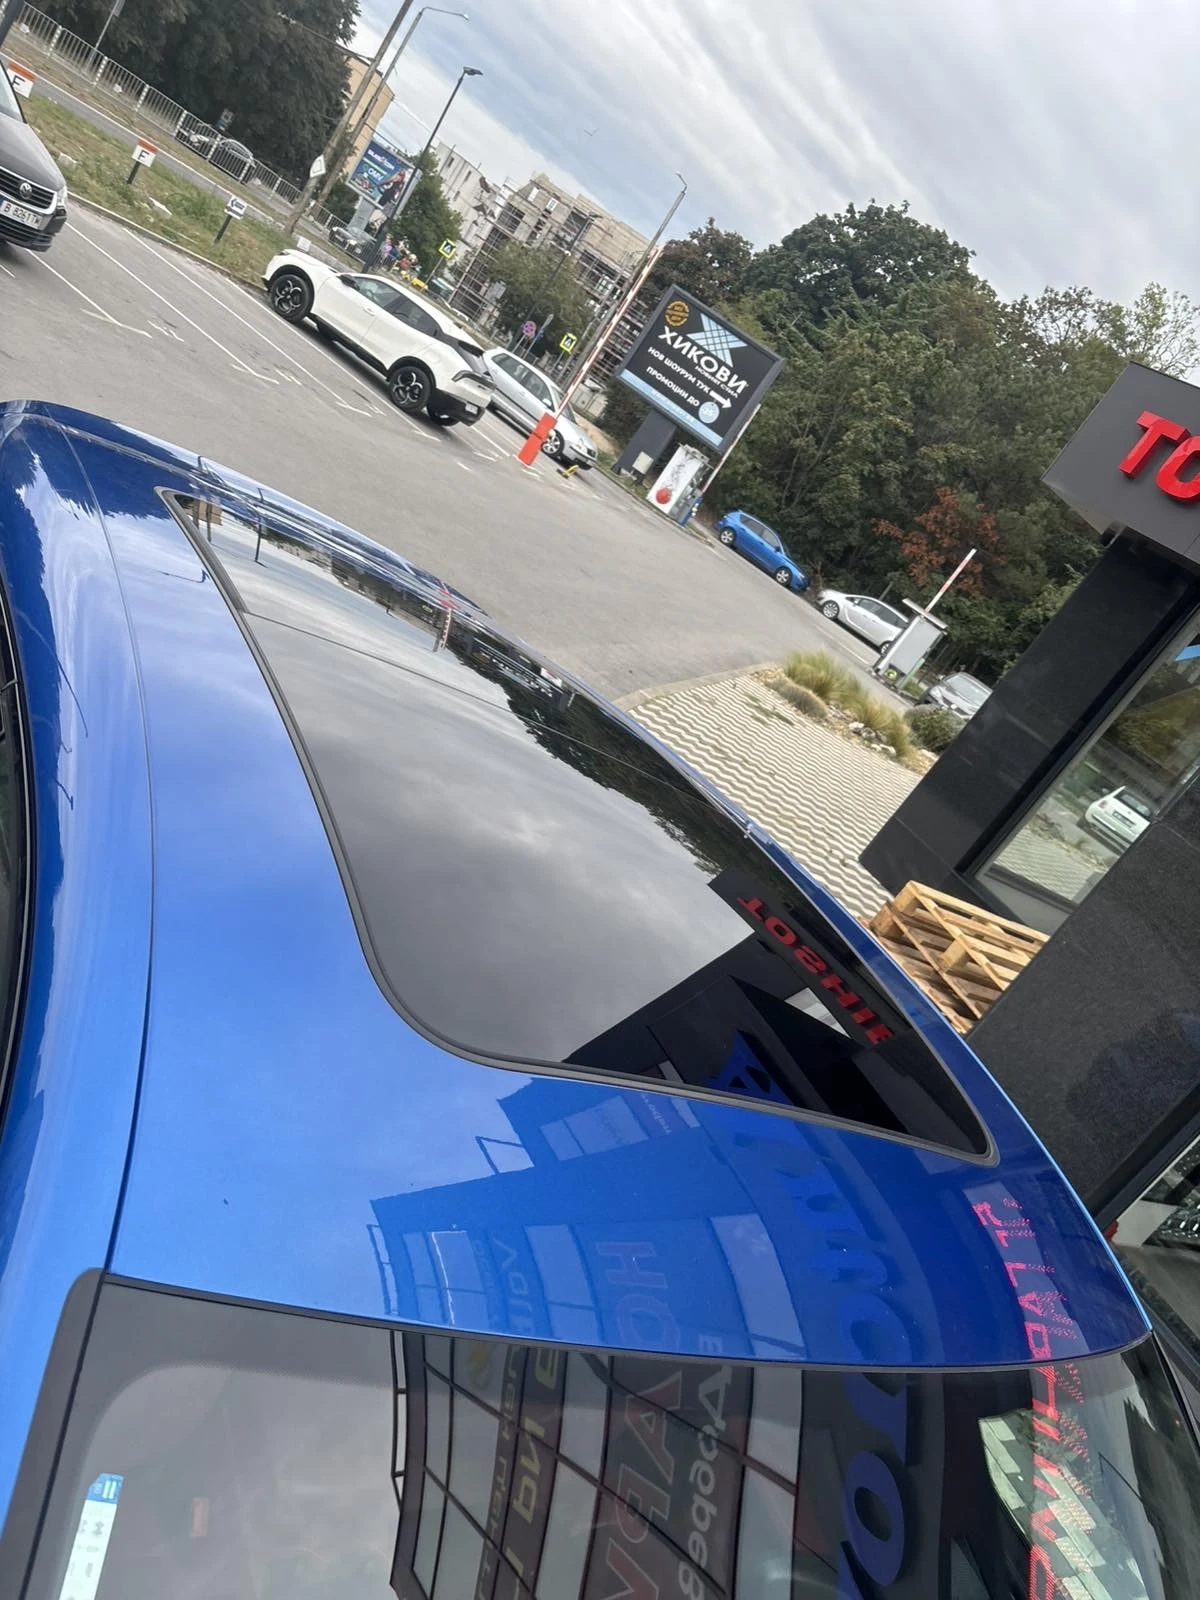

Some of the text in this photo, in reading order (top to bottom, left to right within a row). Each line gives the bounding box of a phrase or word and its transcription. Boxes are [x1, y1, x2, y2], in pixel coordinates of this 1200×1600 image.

[646, 366, 689, 400] ПРОМОЦИИ
[686, 395, 700, 408] ДО
[647, 346, 711, 394] НОВ ШОУРУМ ТУК
[658, 325, 747, 394] ХИКОВИ
[1118, 410, 1200, 503] TO
